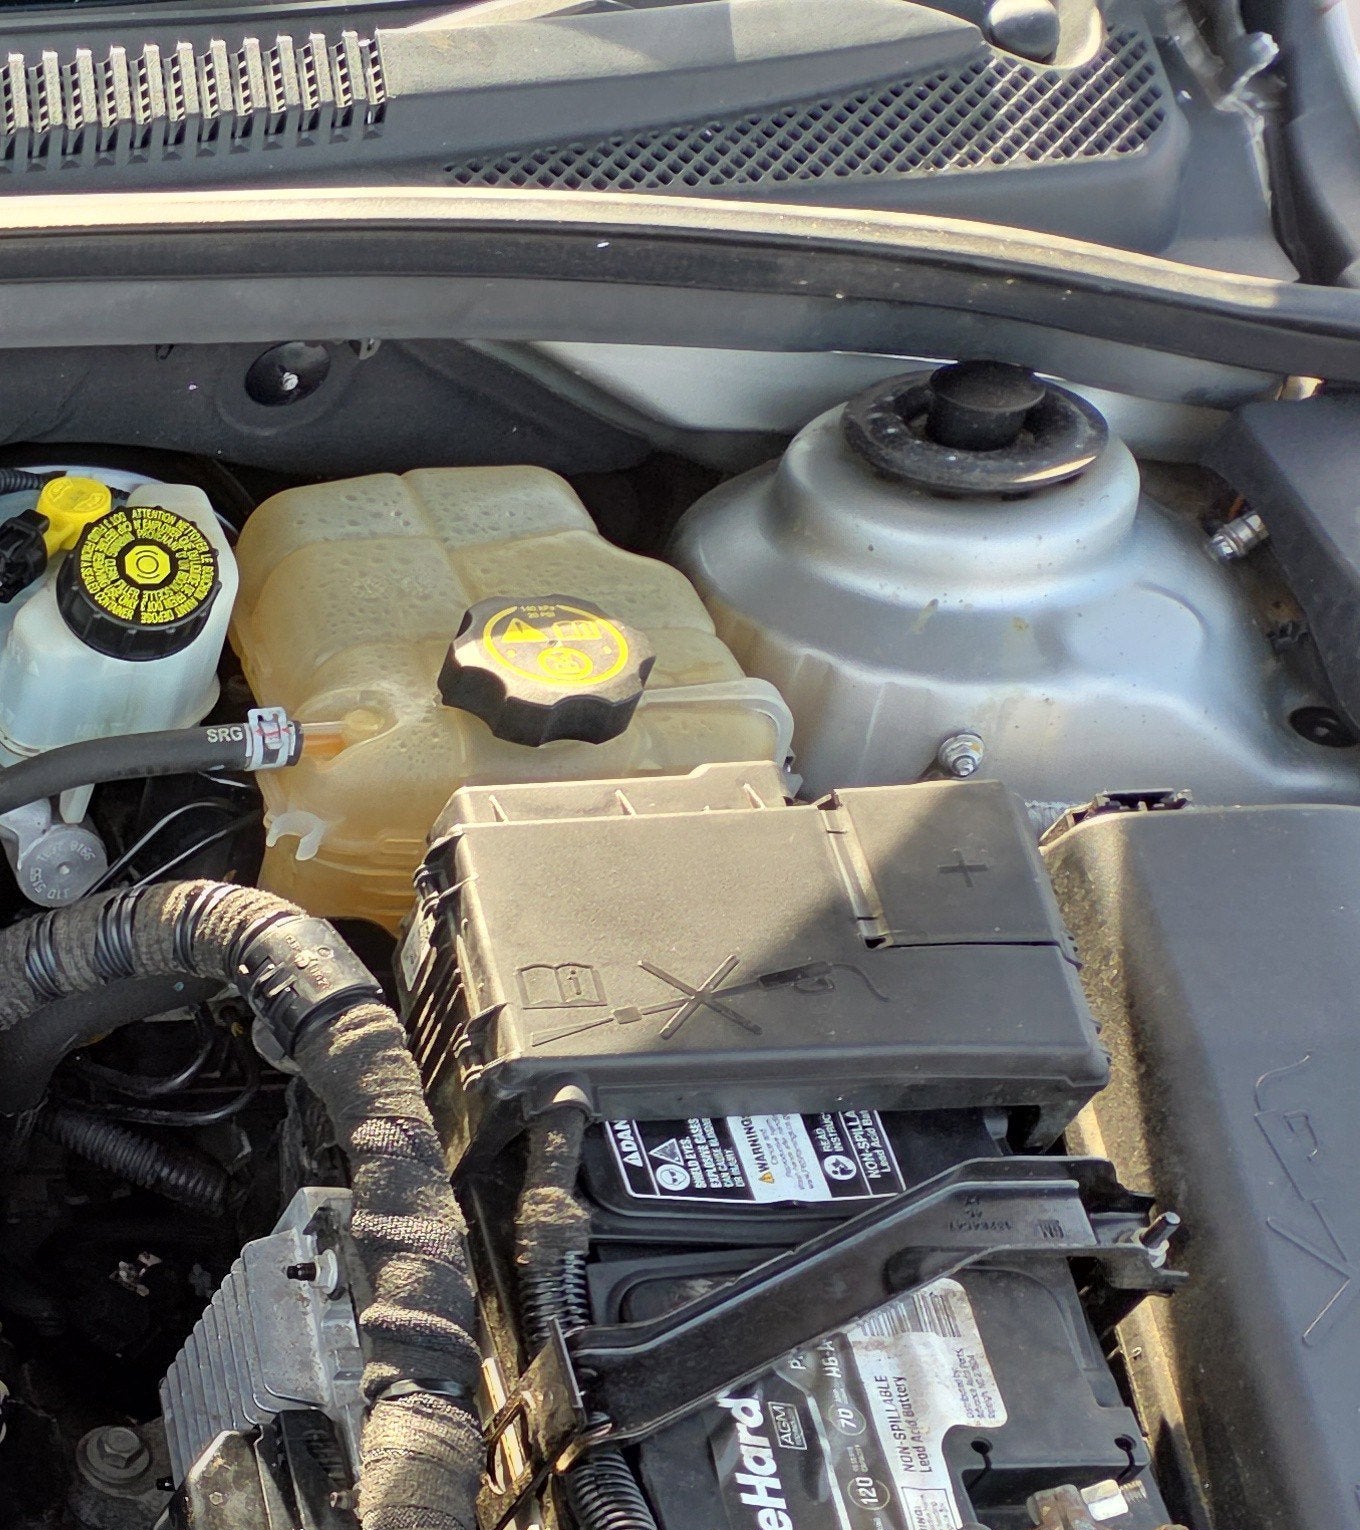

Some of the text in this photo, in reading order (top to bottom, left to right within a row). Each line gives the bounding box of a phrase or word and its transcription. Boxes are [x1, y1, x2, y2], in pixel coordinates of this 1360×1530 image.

[207, 727, 244, 743] SRG
[893, 1377, 915, 1417] Battery
[776, 1405, 794, 1445] AGM
[838, 1408, 856, 1428] 70
[875, 1375, 917, 1472] NON-SPILLABLE
[912, 1446, 932, 1472] Lead
[856, 1477, 879, 1505] 120
